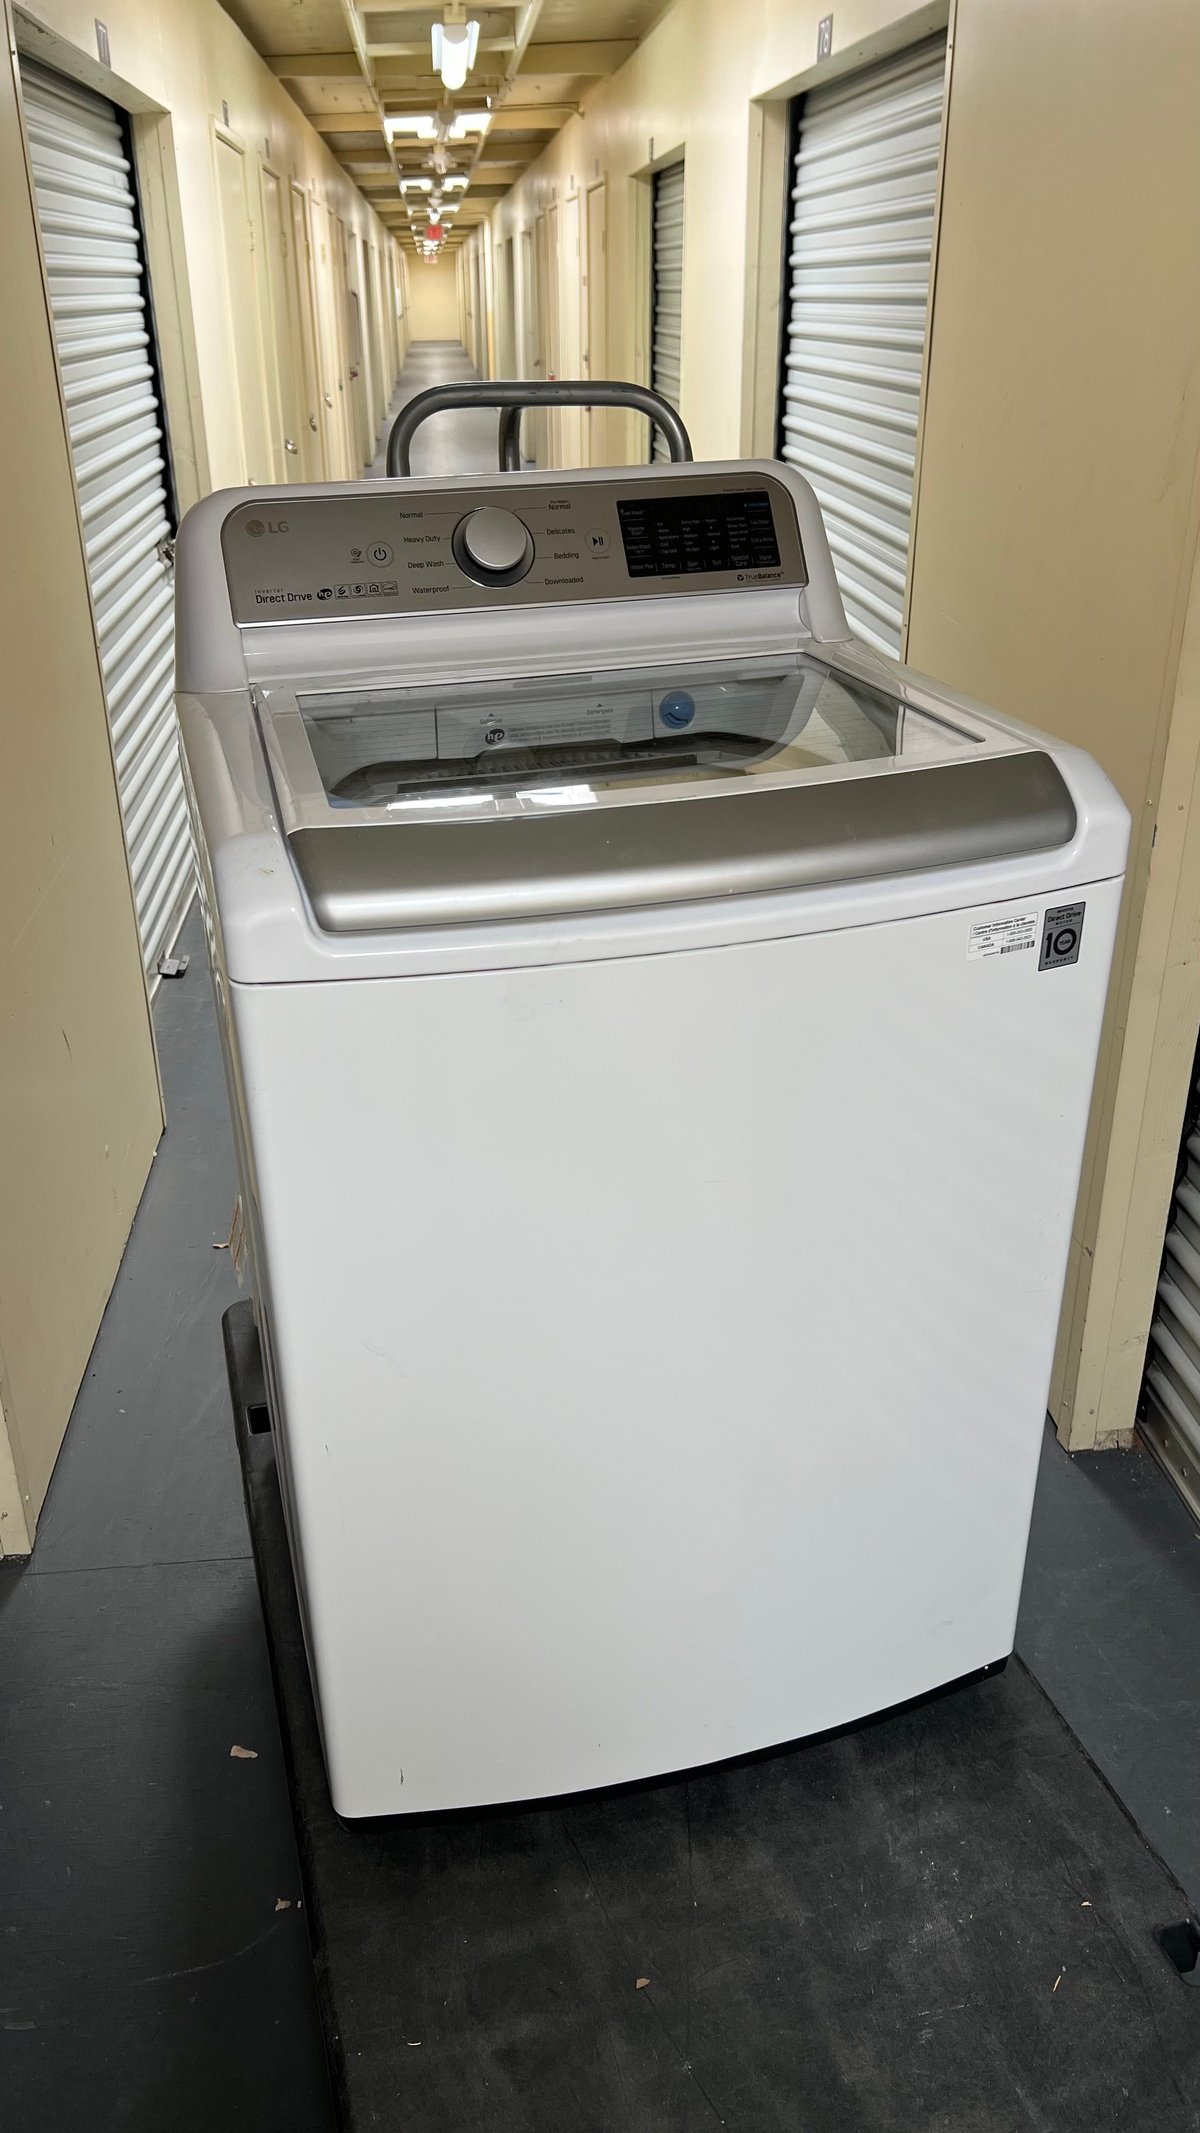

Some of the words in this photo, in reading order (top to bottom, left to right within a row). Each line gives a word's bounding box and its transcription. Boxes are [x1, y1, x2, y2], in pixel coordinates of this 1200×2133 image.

[268, 521, 290, 534] LG
[546, 527, 576, 535] Delicates
[403, 536, 424, 544] Heavy
[425, 535, 441, 543] Duty
[553, 551, 580, 560] Bedding
[407, 561, 425, 570] Deep
[425, 560, 445, 568] Wash
[544, 576, 584, 585] Downloaded
[412, 585, 450, 594] Waterproof
[255, 594, 286, 604] Direct
[287, 592, 313, 602] Drive
[486, 730, 504, 744] he
[1047, 914, 1065, 923] Direct
[1066, 911, 1082, 919] Drive
[1045, 928, 1077, 958] 10
